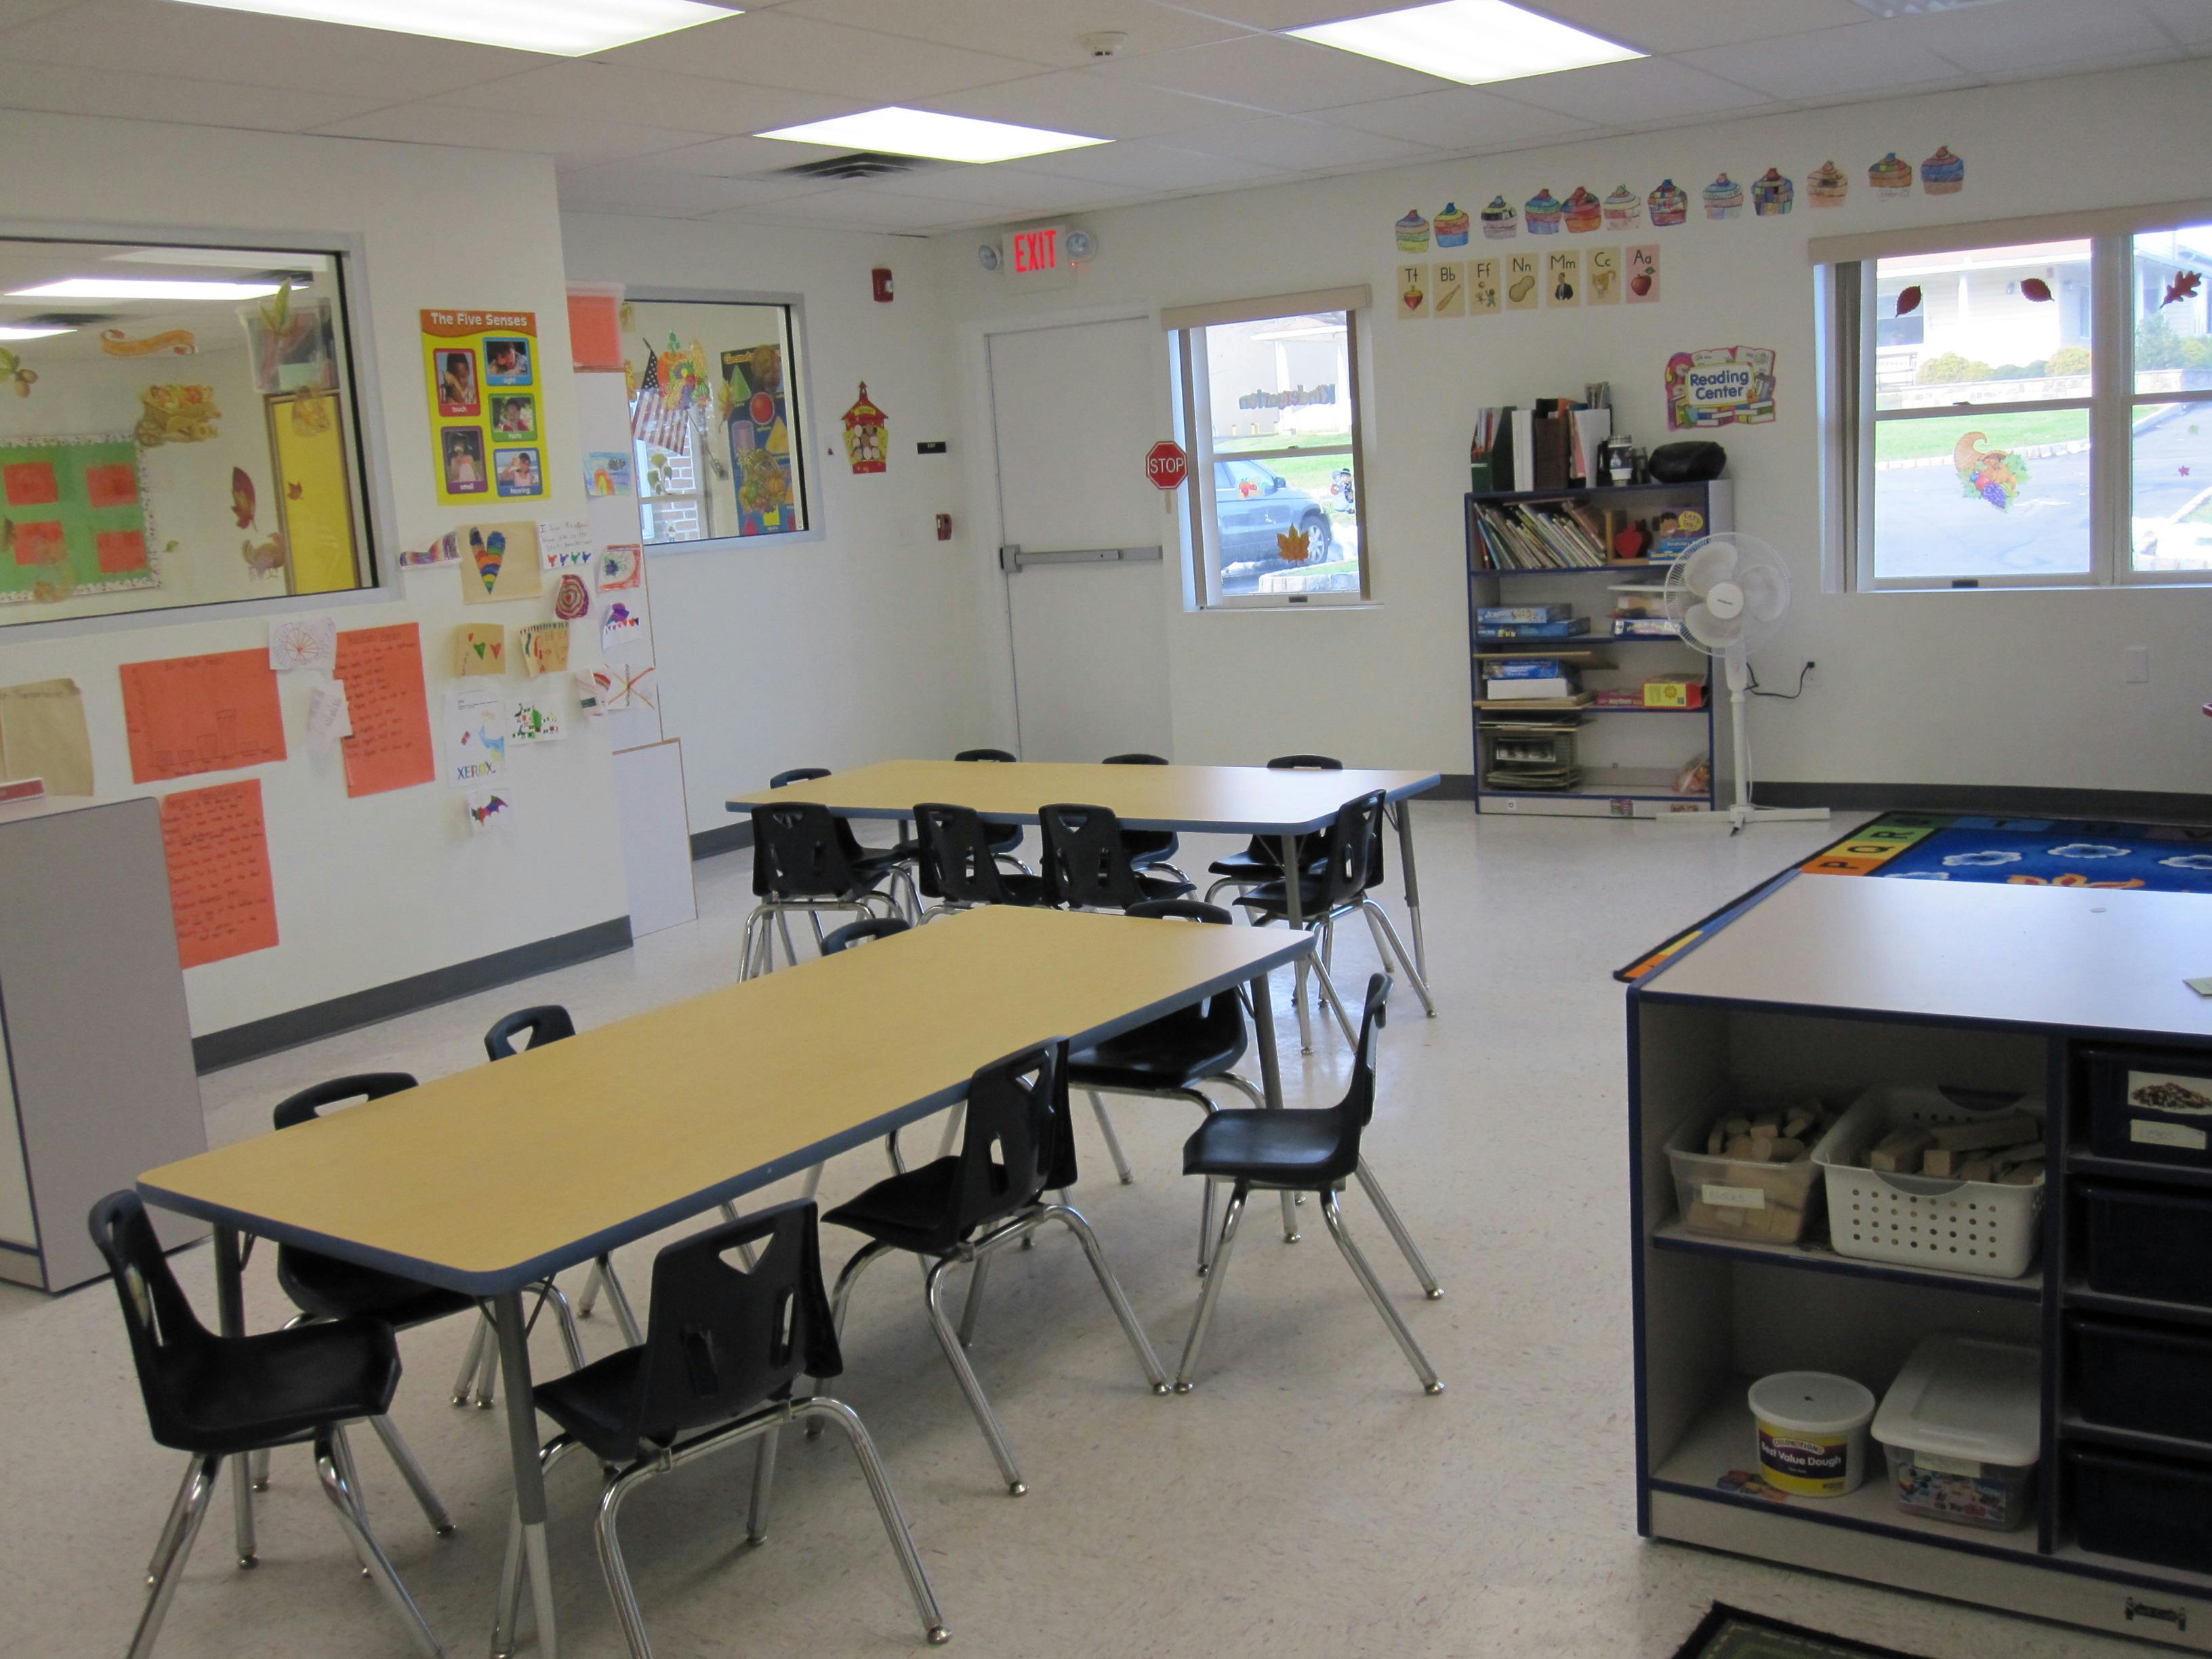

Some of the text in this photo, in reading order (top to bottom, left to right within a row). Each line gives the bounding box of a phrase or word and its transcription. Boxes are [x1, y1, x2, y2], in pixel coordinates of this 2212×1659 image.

[1015, 230, 1057, 272] EXIT
[1633, 249, 1652, 264] Aa
[1513, 258, 1532, 272] Nn
[1551, 255, 1576, 270] Mm
[1595, 252, 1612, 267] Cc
[1405, 268, 1418, 282] Tt
[1441, 267, 1456, 281] Bb
[1477, 262, 1490, 278] Ff
[431, 312, 527, 327] The Five Senses
[1690, 370, 1749, 386] Reading
[1696, 386, 1744, 400] Center
[1149, 457, 1185, 474] STOP
[1869, 830, 1916, 840] R
[1847, 845, 1896, 855] Q
[1818, 860, 1860, 871] P
[1761, 1441, 1842, 1468] Best Value Dough
